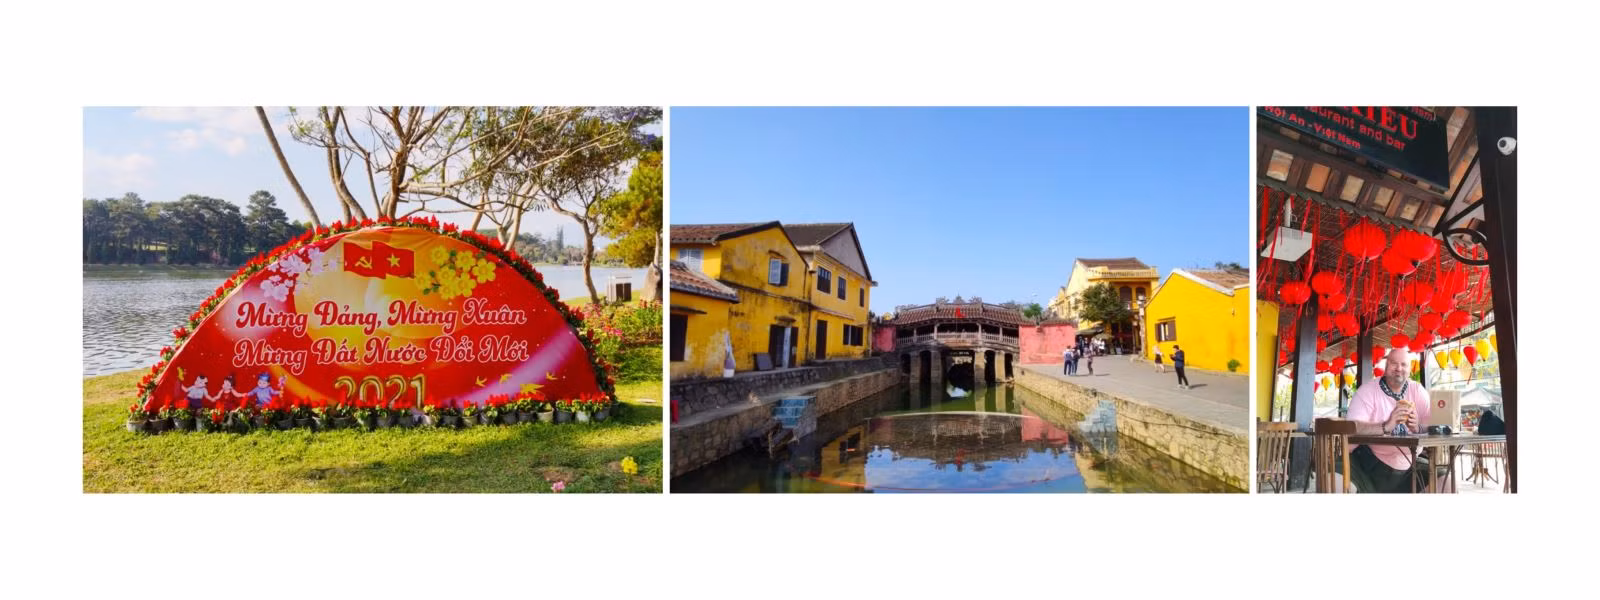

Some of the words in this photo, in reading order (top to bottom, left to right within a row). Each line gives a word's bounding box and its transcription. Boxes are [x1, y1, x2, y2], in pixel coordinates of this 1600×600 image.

[1289, 113, 1305, 127] An
[1359, 124, 1383, 141] and
[1386, 133, 1406, 151] bar
[235, 301, 308, 337] Mừng
[314, 301, 382, 336] Đảng,
[387, 299, 459, 335] Mừng
[462, 298, 527, 325] Xuân
[232, 338, 307, 375] Mừng
[312, 337, 358, 365] Đất
[362, 336, 427, 365] Nước
[430, 336, 475, 362] Đổi
[478, 335, 530, 362] Mới
[335, 374, 426, 409] 2021
